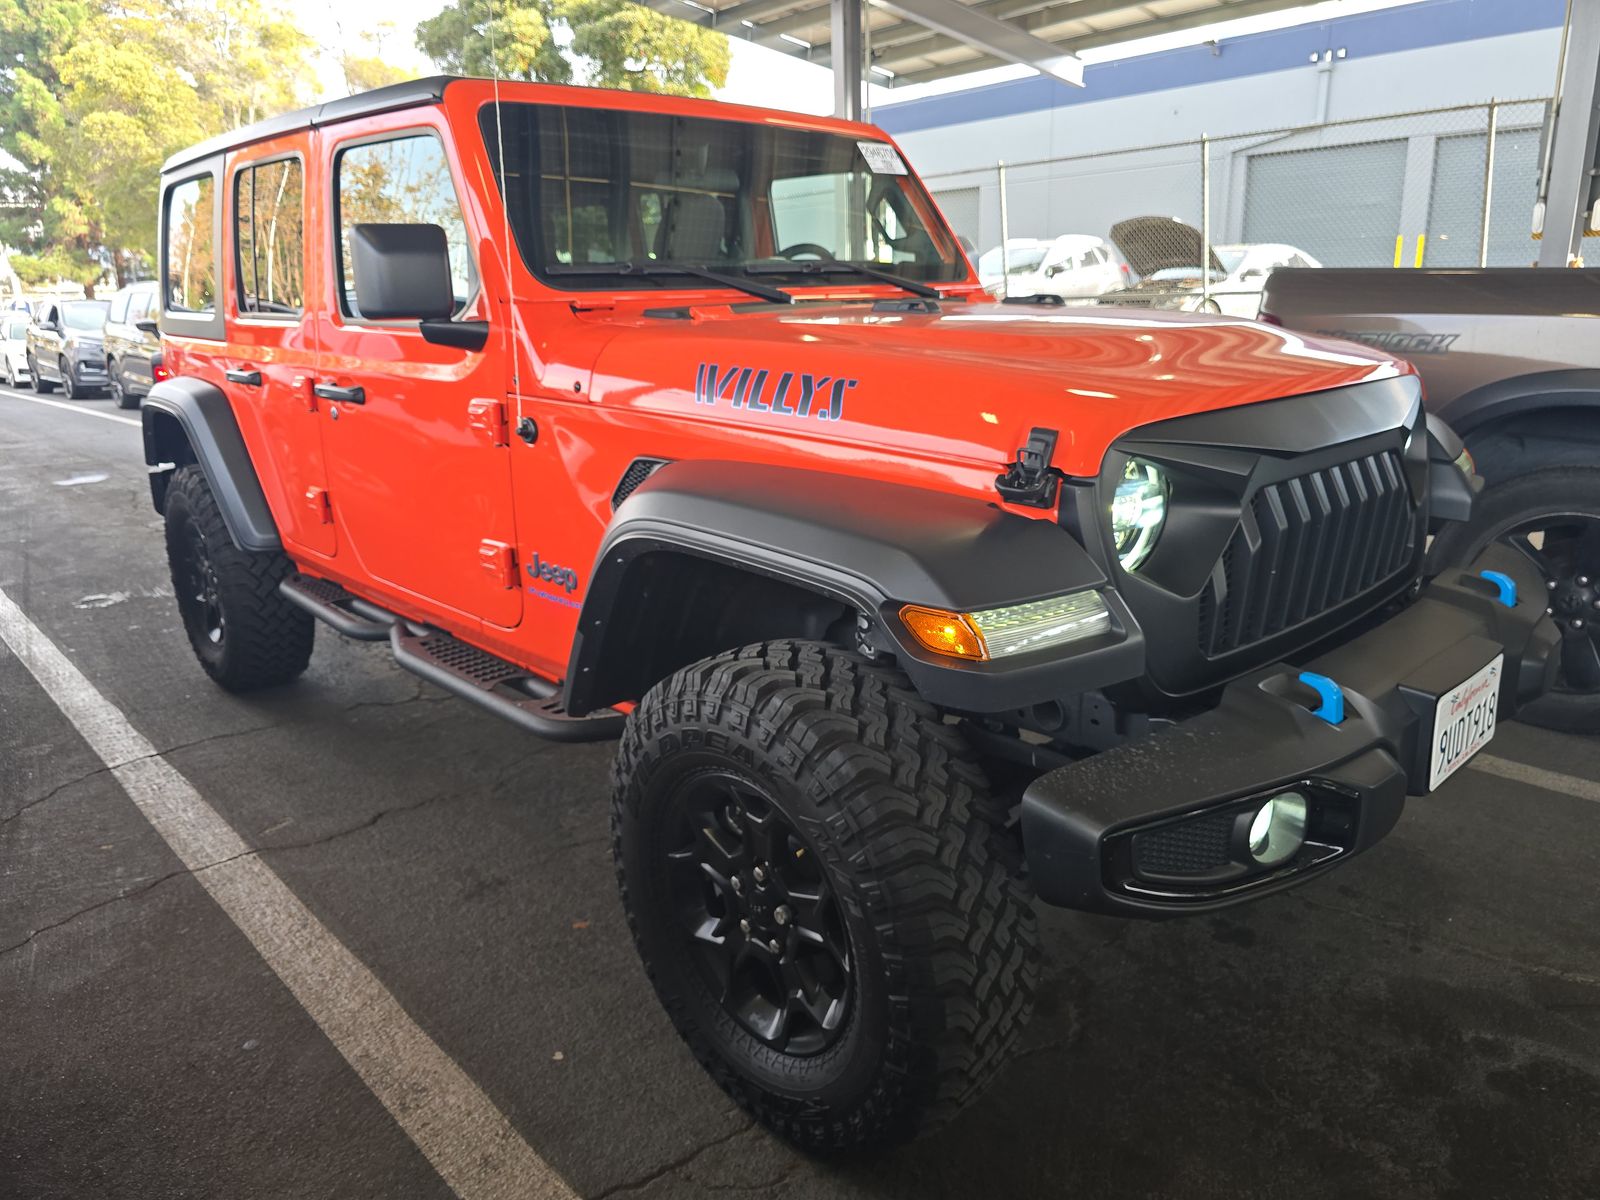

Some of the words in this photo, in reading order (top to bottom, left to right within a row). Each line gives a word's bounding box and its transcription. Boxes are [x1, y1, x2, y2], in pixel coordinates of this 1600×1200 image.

[696, 363, 859, 421] WILLYS
[526, 552, 578, 594] Jeep
[1437, 691, 1496, 775] 9UDT918
